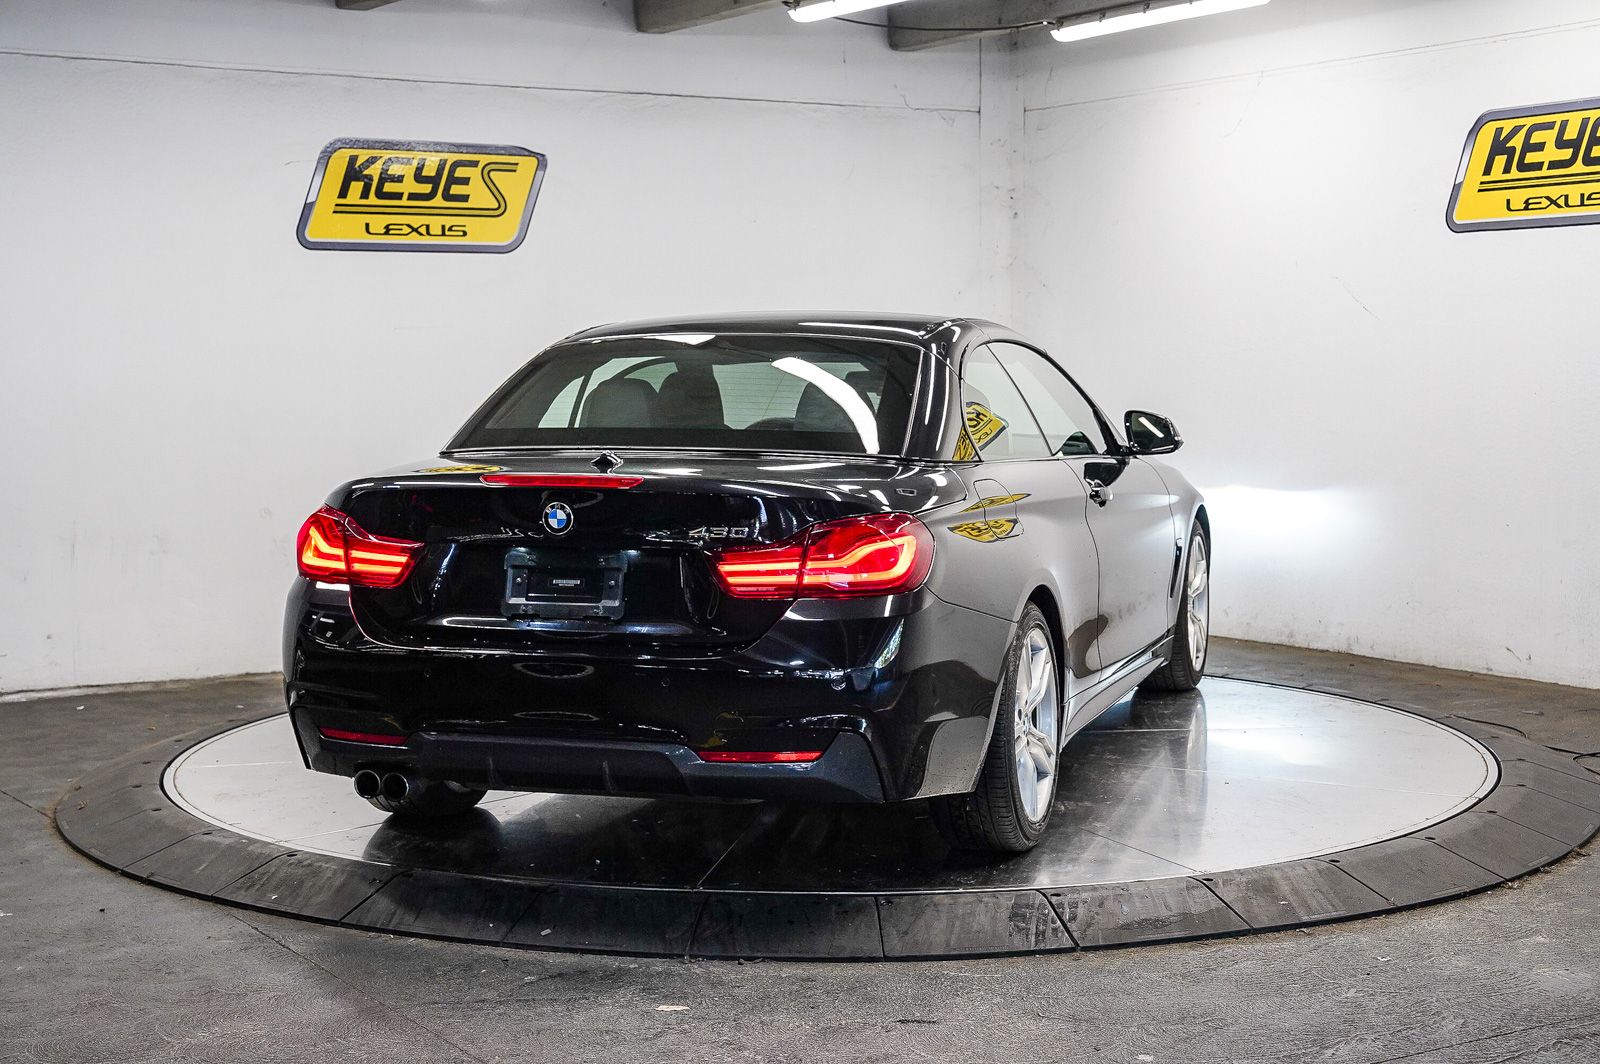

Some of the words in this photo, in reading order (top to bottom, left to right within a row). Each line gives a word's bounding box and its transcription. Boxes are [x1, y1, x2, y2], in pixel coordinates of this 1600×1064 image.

[335, 154, 520, 216] KEYES
[1506, 192, 1600, 212] LEXUS
[365, 222, 467, 238] LEXUS
